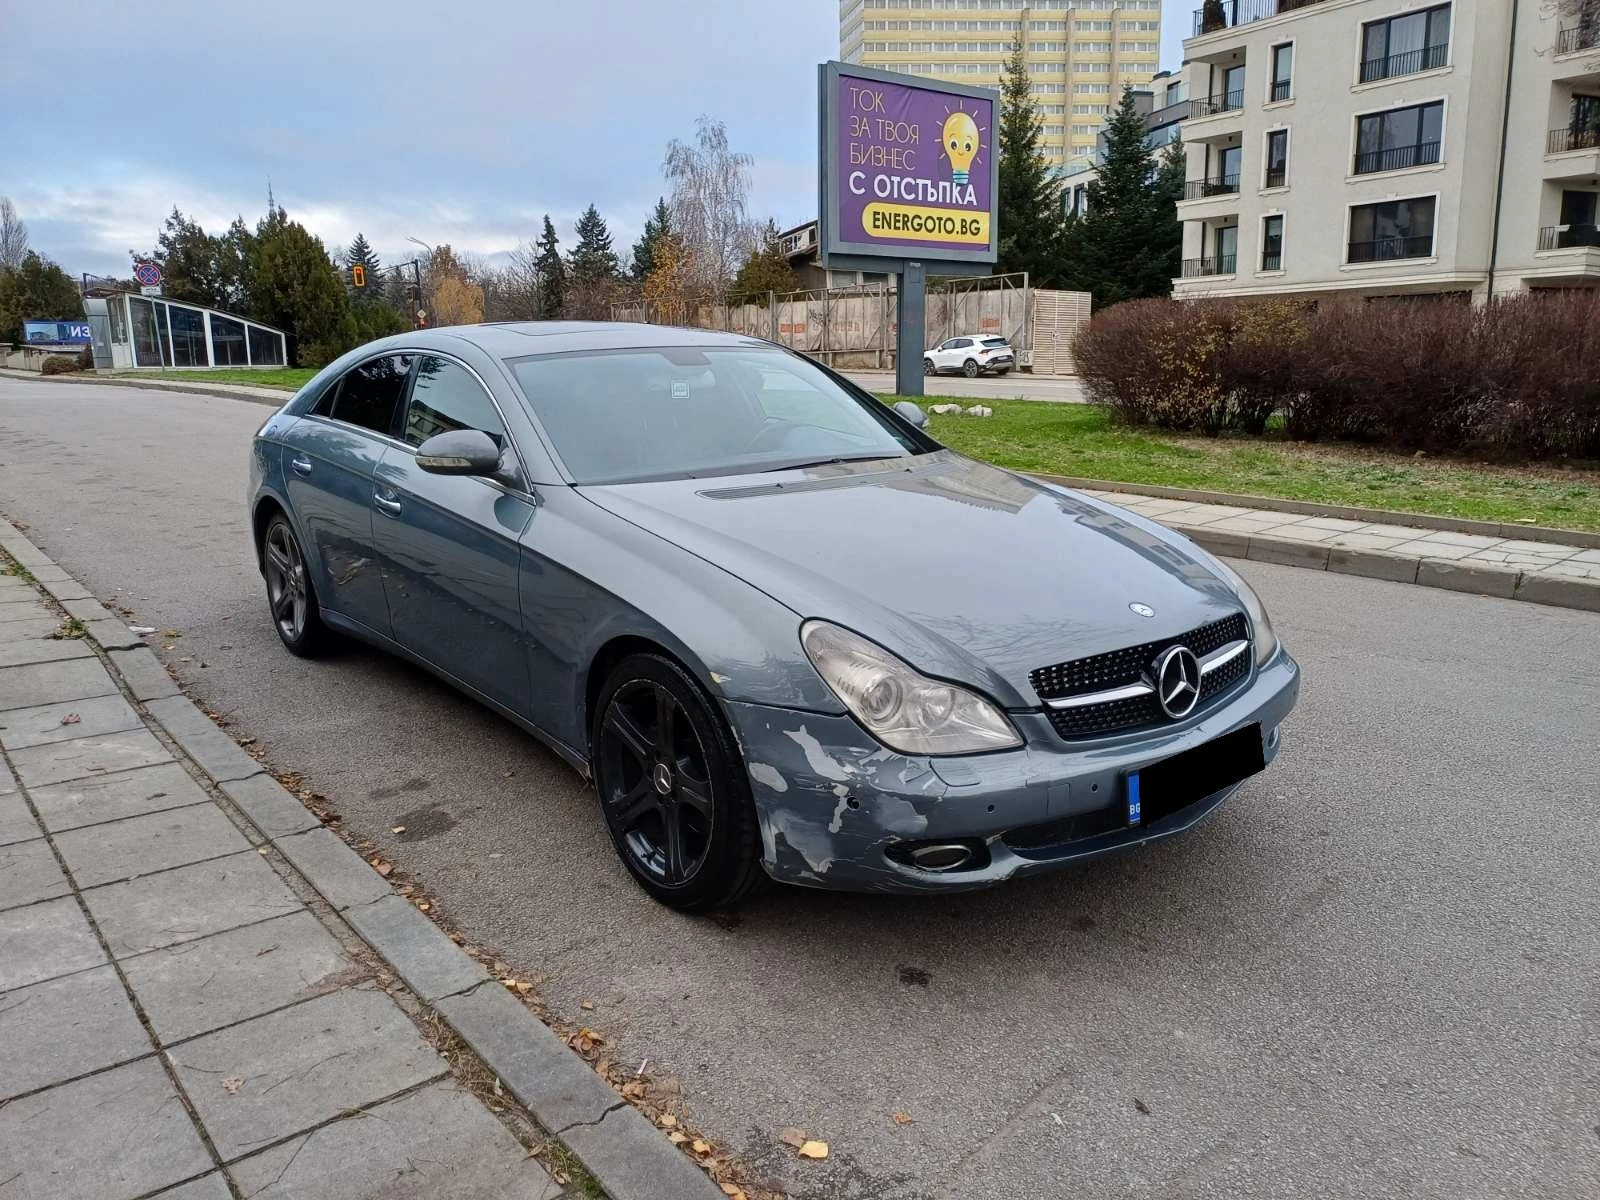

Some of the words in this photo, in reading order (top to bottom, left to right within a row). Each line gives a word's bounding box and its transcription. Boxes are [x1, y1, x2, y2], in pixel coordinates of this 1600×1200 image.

[850, 87, 886, 113] ТОК
[849, 115, 871, 138] ЗА
[876, 118, 919, 144] ТВОЯ
[849, 142, 916, 171] БИЗНЕС
[849, 170, 866, 195] С
[873, 174, 978, 205] ОТСТЪПКА
[872, 211, 981, 236] ENERGOTO.BG
[1129, 802, 1141, 815] BG
